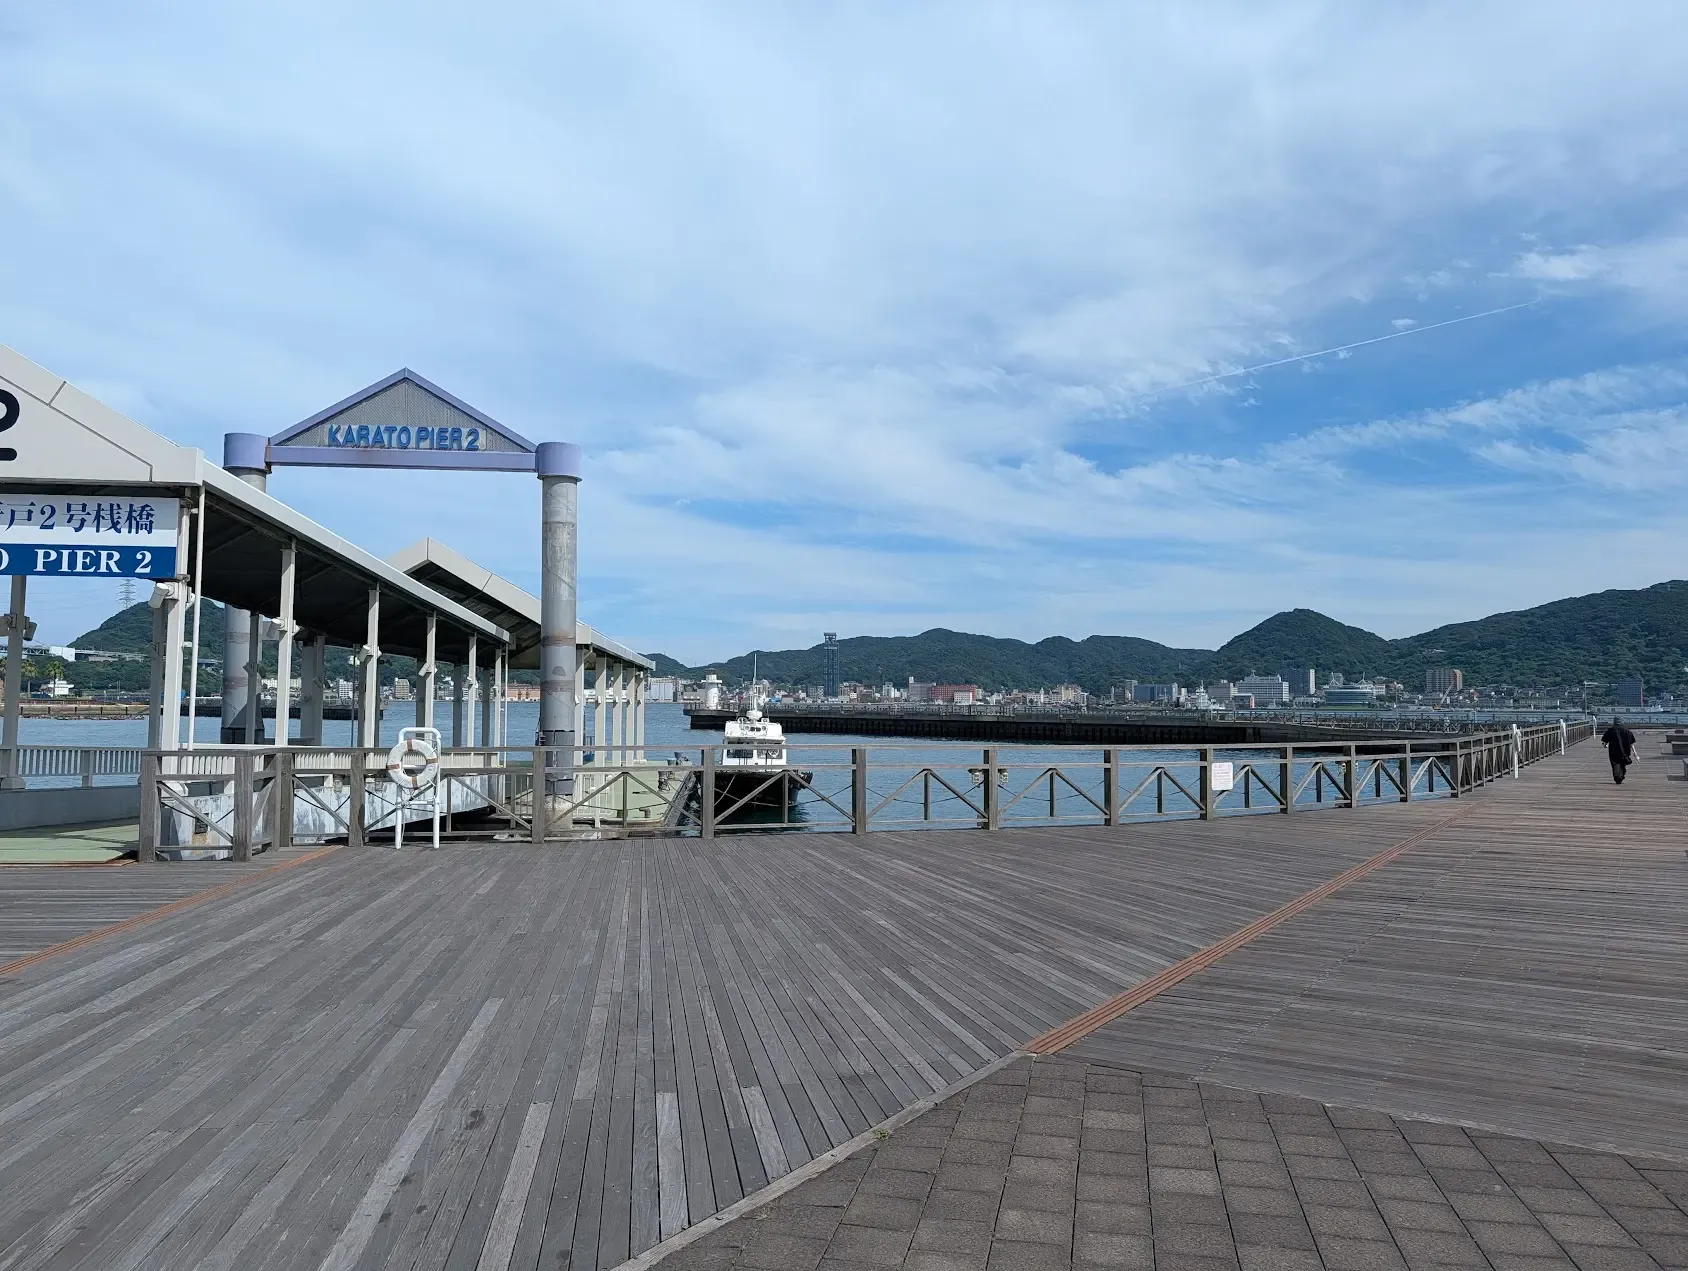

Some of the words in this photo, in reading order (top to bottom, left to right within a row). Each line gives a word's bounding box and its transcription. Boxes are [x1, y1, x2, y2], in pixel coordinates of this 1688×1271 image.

[328, 424, 411, 449] KARATO
[415, 426, 462, 450] PIER
[465, 428, 480, 451] 2
[0, 501, 155, 534] 戸2号桟橋
[33, 548, 122, 573] PIER
[135, 550, 152, 574] 2
